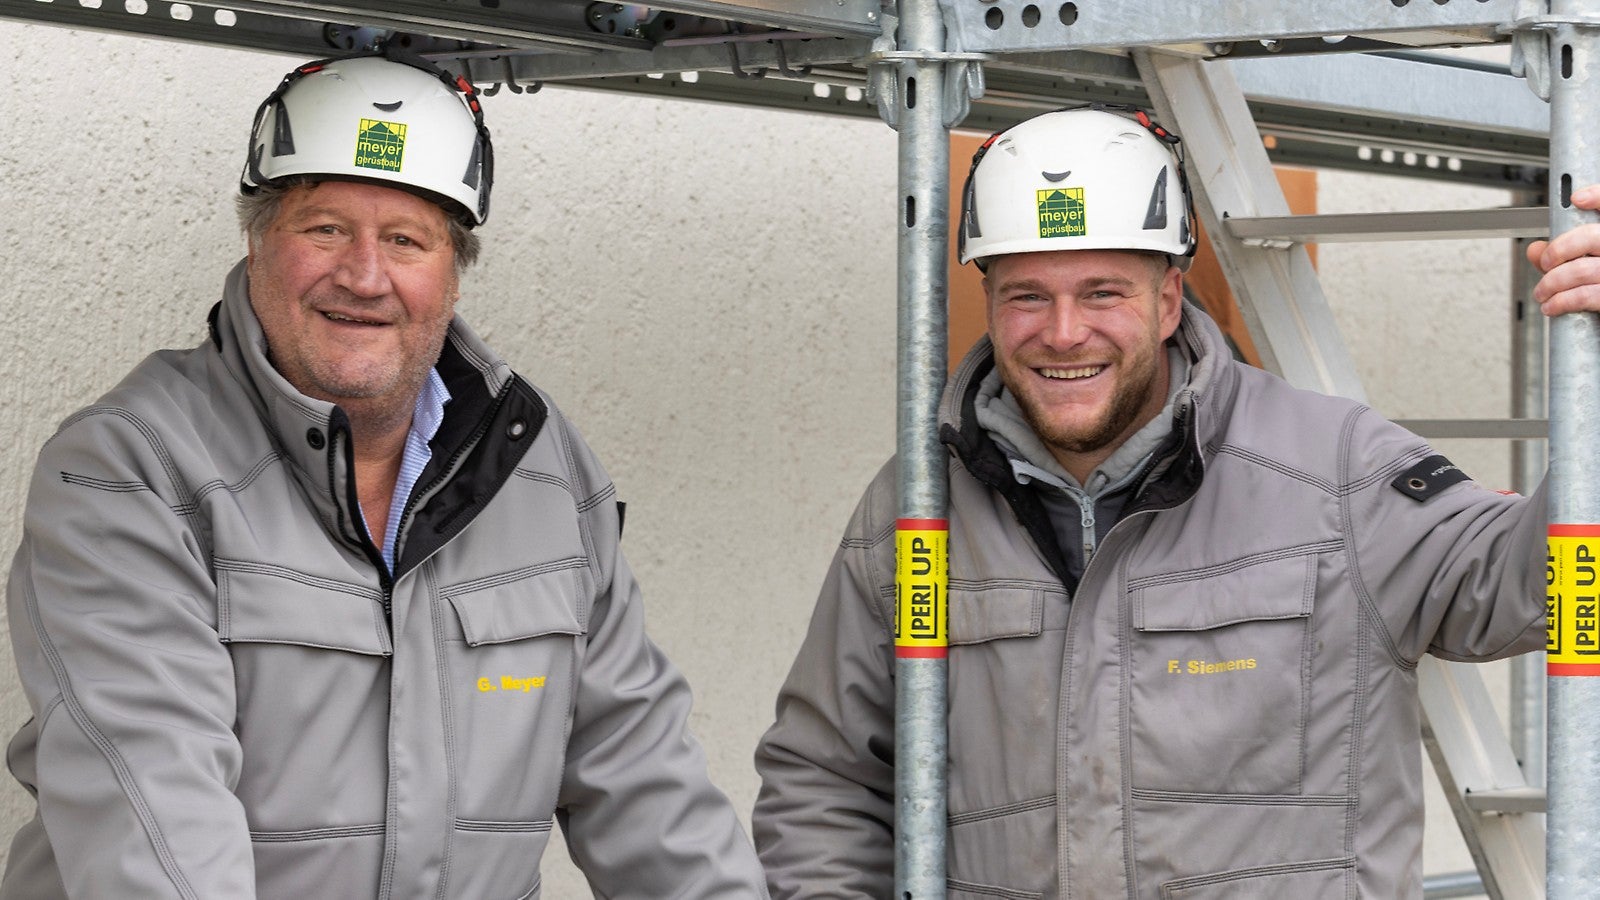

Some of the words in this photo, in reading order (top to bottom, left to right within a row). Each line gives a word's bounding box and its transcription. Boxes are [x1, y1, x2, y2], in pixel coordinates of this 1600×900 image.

[359, 141, 402, 156] meyer
[357, 156, 400, 168] gerüstbau
[1040, 210, 1083, 224] meyer
[1041, 225, 1084, 236] gerüstbau
[911, 537, 931, 576] UP
[1575, 544, 1596, 586] UP
[911, 585, 931, 630] PERI
[1575, 596, 1596, 645] PERI
[1167, 660, 1182, 674] F.
[1187, 658, 1257, 674] Siemens
[477, 677, 497, 692] G.
[501, 675, 546, 692] Meyer
